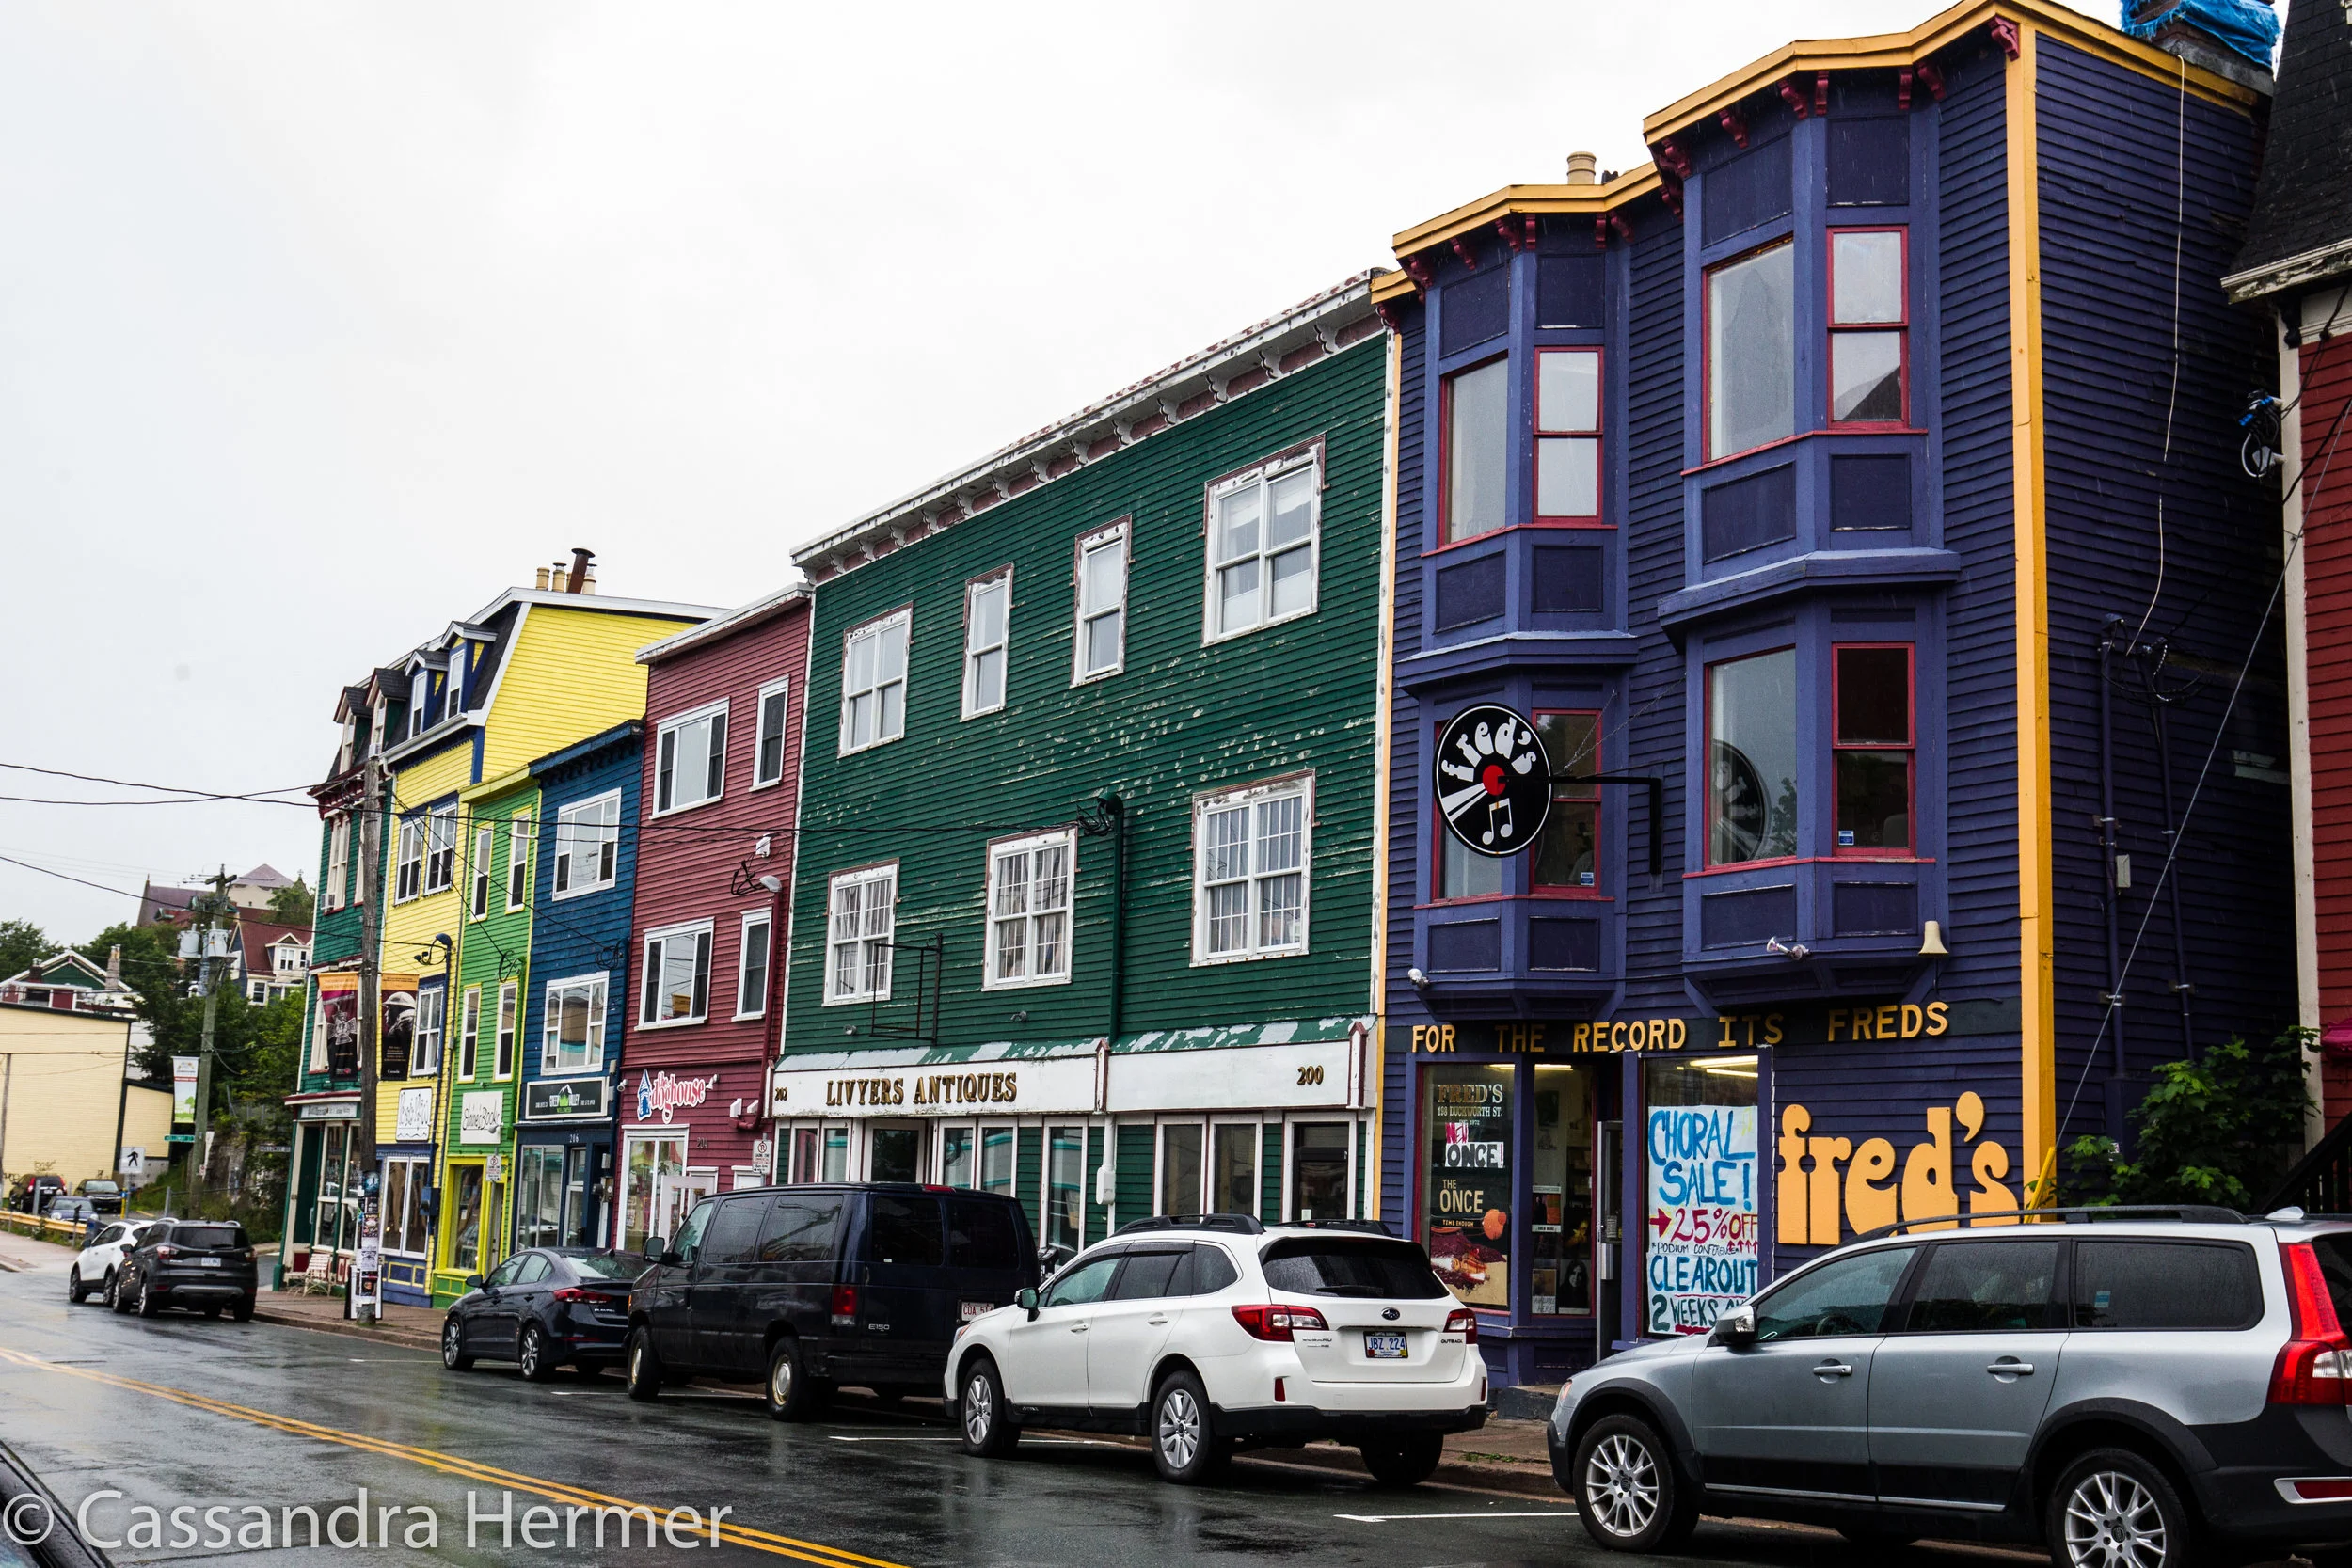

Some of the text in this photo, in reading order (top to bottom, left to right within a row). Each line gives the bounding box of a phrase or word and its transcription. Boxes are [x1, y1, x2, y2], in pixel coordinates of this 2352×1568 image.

[1441, 717, 1537, 782] fred's
[1412, 1002, 1949, 1053] FOR THE RECORD ITS FREDS
[826, 1072, 1017, 1106] LIVYERS ANTIQUES
[1297, 1065, 1324, 1085] 200
[651, 1075, 705, 1123] doghouse
[774, 1087, 787, 1101] 202
[1438, 1084, 1503, 1103] FRED'S
[1450, 1106, 1490, 1117] DUCKWORTH
[1492, 1106, 1503, 1117] ST.
[1447, 1143, 1503, 1167] ONCE!
[1648, 1110, 1756, 1166] CHORAL
[1442, 1179, 1457, 1189] THE
[1777, 1091, 2020, 1245] fred's
[1439, 1189, 1484, 1213] ONCE
[1659, 1160, 1752, 1212] SALE!
[1671, 1208, 1757, 1244] 25% OFF
[1649, 1255, 1757, 1295] CLEAROUT
[1652, 1294, 1719, 1331] 2 WEEKS
[1368, 1338, 1406, 1351] JBZ 224
